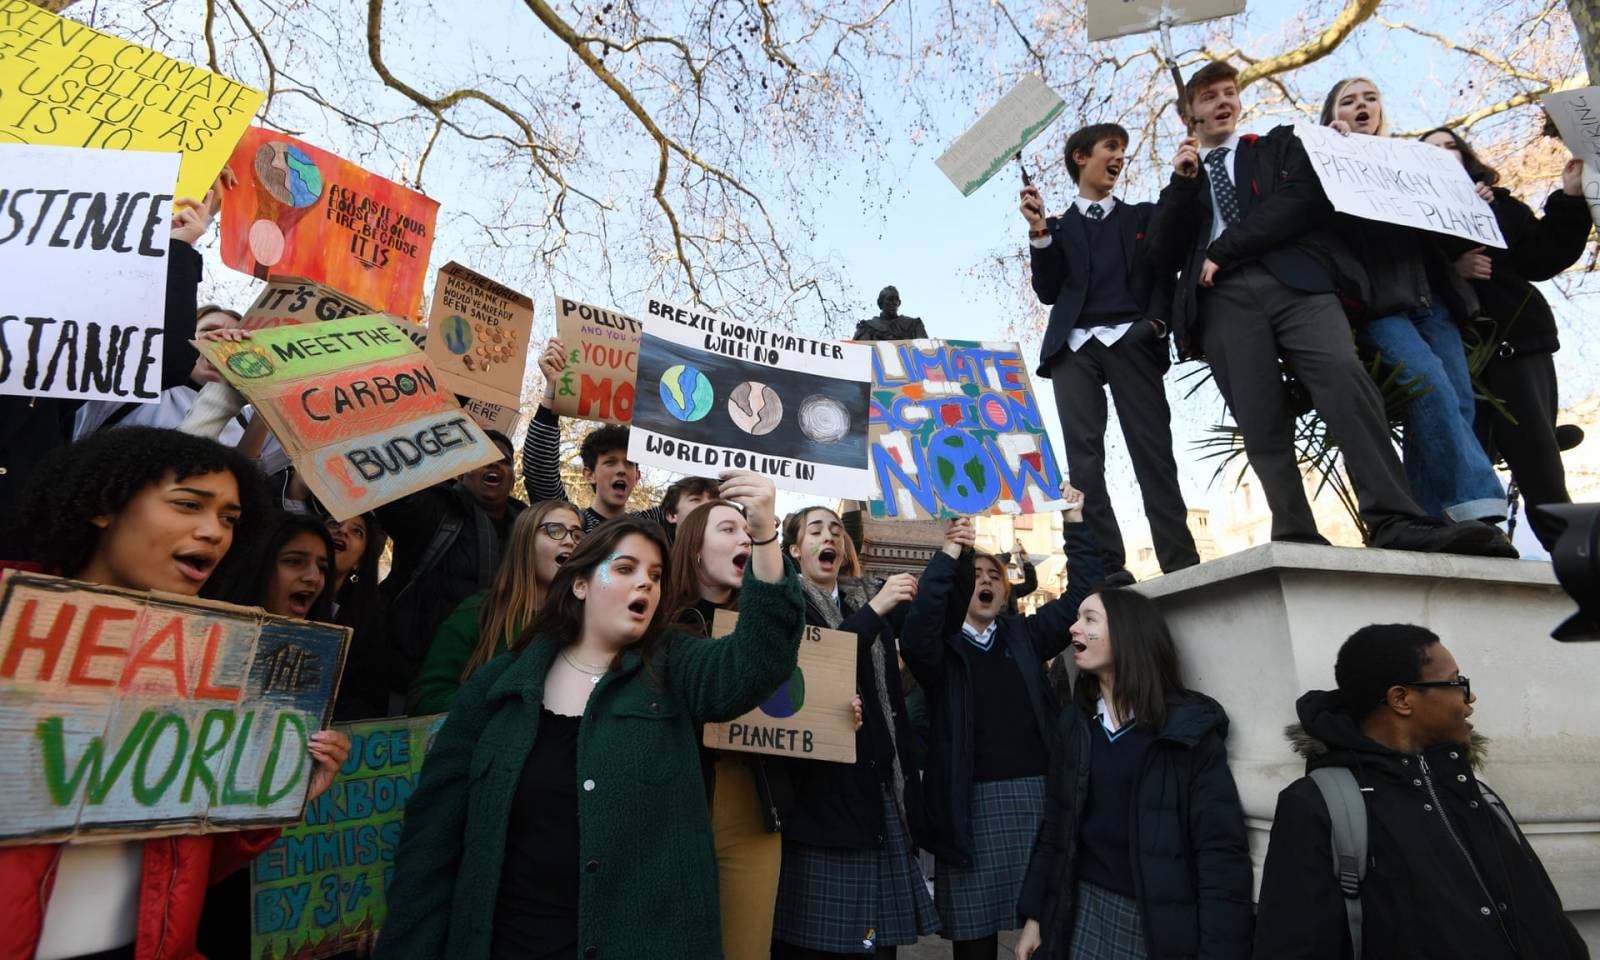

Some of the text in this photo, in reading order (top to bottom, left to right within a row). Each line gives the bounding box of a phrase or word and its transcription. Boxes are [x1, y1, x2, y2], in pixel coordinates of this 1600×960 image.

[61, 54, 232, 130] POLICIES
[113, 45, 257, 112] CLIMATE
[10, 98, 133, 150] IS TO
[18, 67, 213, 152] USEFUL AS
[1313, 150, 1440, 198] PATRIARCHY
[361, 196, 380, 214] AS
[396, 211, 426, 237] YOUR
[376, 217, 388, 232] IS
[1355, 190, 1500, 242] THE PLANET
[351, 234, 390, 267] IT IS
[363, 224, 418, 259] BECAUSE
[258, 286, 316, 312] IT'S
[443, 296, 499, 326] BEEN SAVED
[448, 276, 466, 291] WAS
[475, 288, 498, 305] BANK
[500, 299, 509, 310] IT
[271, 332, 353, 362] MEET
[347, 327, 401, 347] THE
[581, 325, 602, 336] AND
[607, 330, 626, 341] YOU
[648, 299, 717, 333] BREXIT
[771, 332, 844, 360] MATTER
[704, 334, 779, 365] WITH NO
[301, 365, 437, 421] CARBON
[869, 390, 1041, 432] ACTION
[344, 419, 477, 482] BUDGET
[646, 435, 815, 480] WORLD TO LIVE IN
[872, 427, 1062, 517] NOW
[1, 599, 241, 701] HEAL
[806, 626, 821, 642] IS
[36, 709, 307, 807] WORLD
[729, 724, 814, 753] PLANET B
[255, 882, 312, 936] BY
